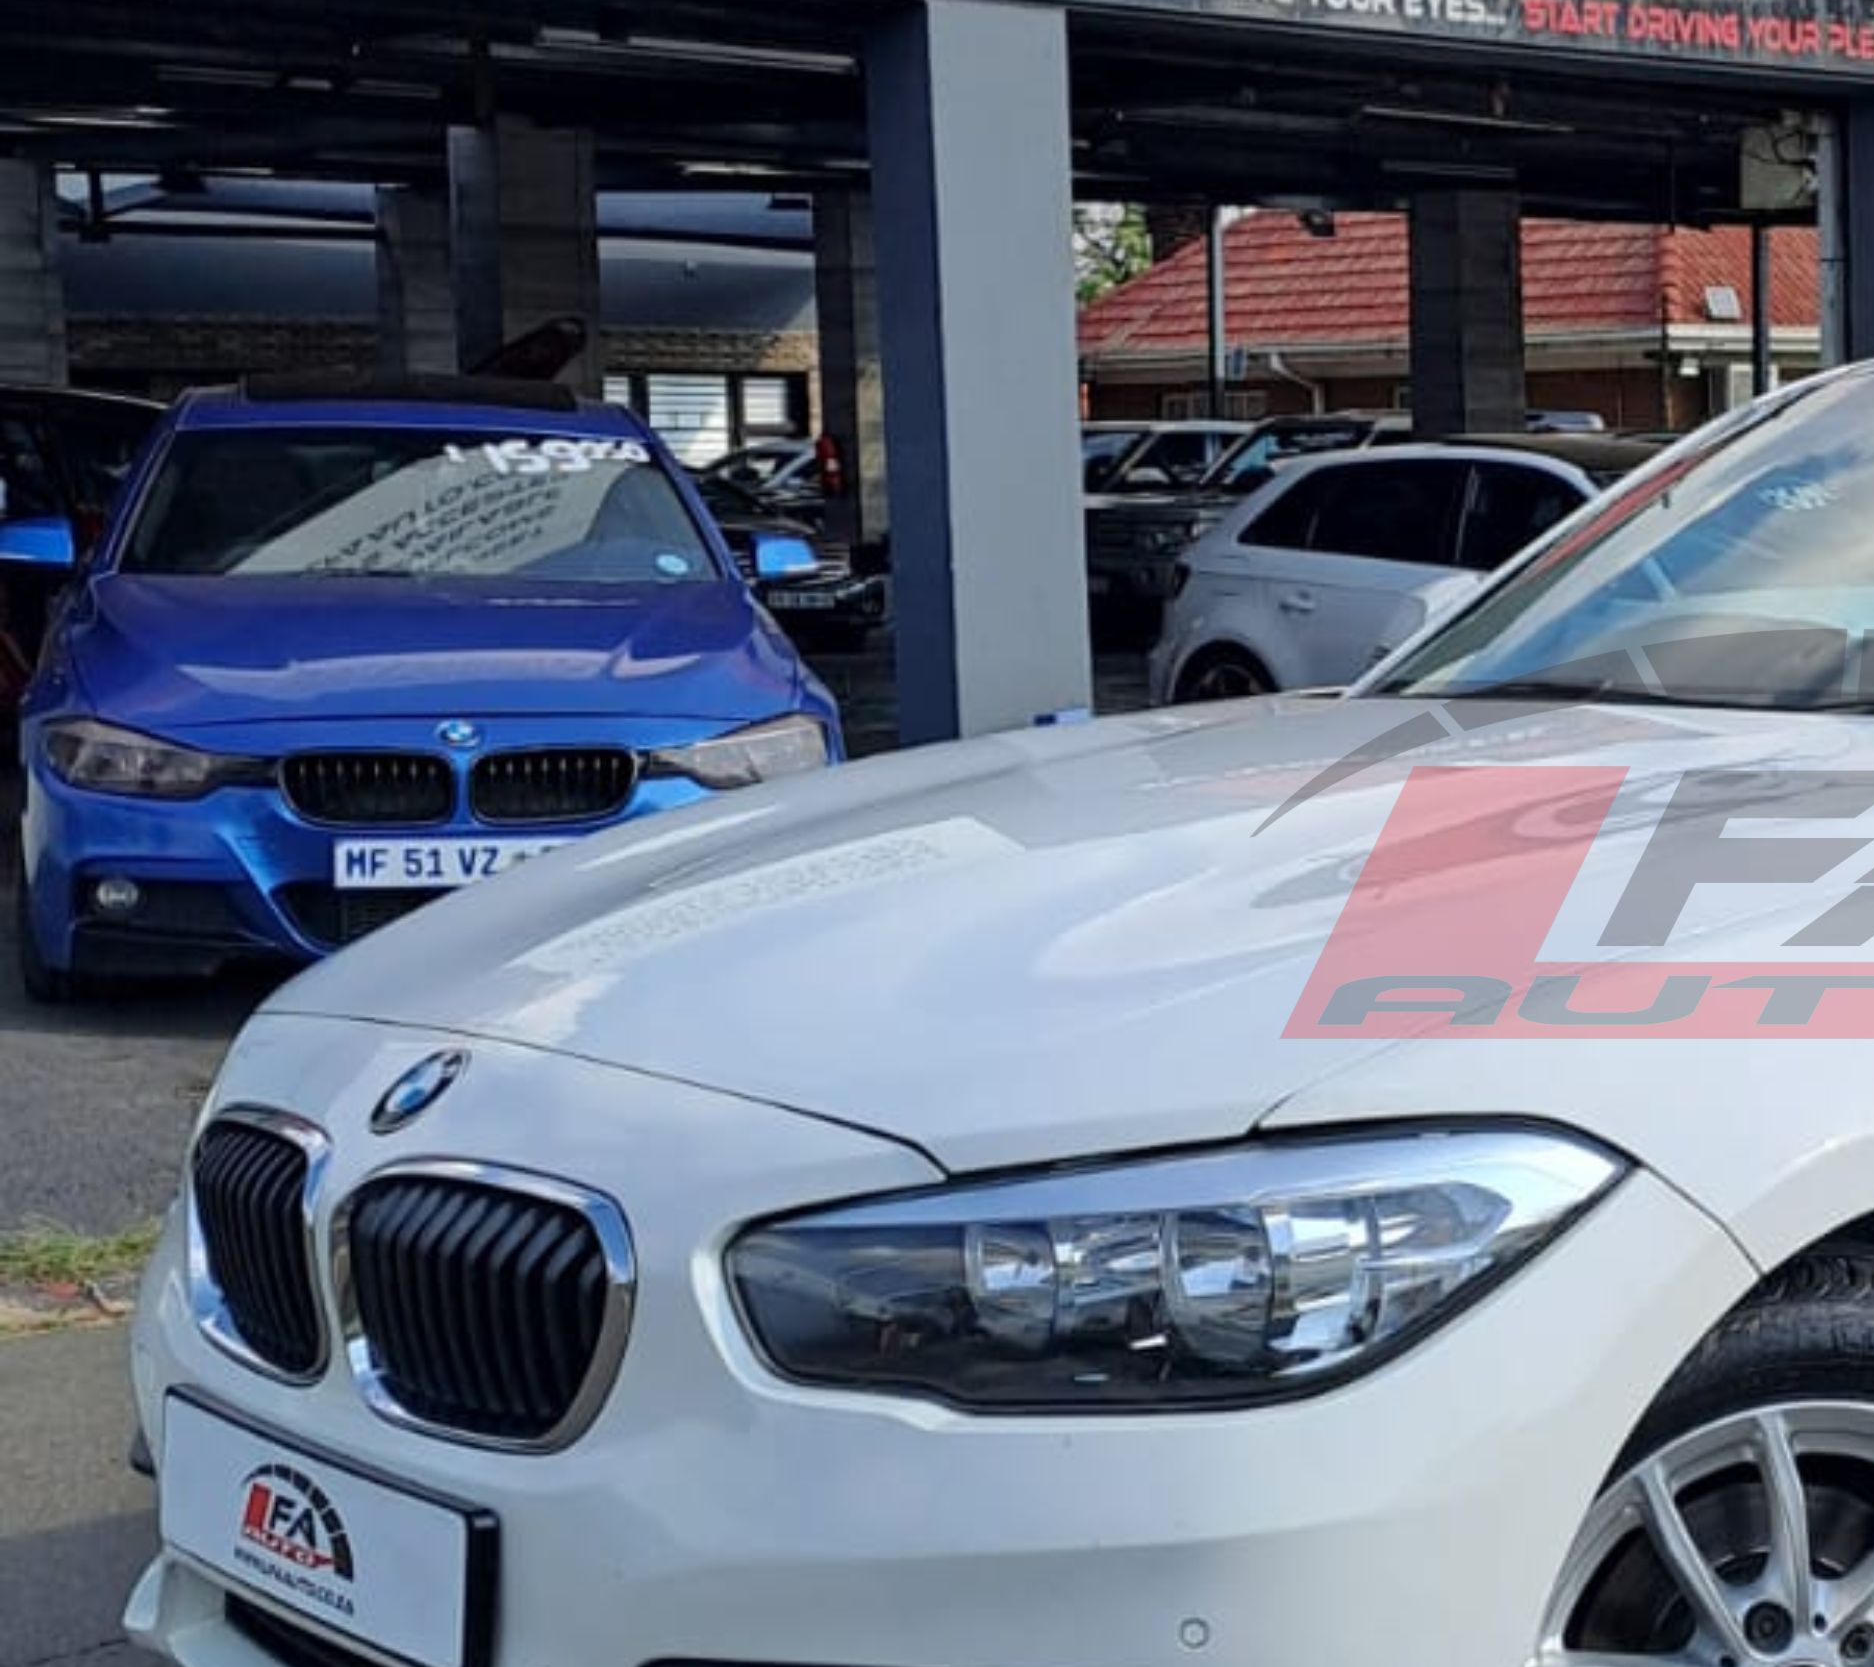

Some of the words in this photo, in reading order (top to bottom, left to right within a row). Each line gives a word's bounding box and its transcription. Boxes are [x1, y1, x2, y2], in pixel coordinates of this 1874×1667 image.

[1627, 7, 1739, 49] DRIVING
[1746, 17, 1822, 55] YOUR
[402, 848, 444, 878] 51
[457, 846, 499, 876] VZ
